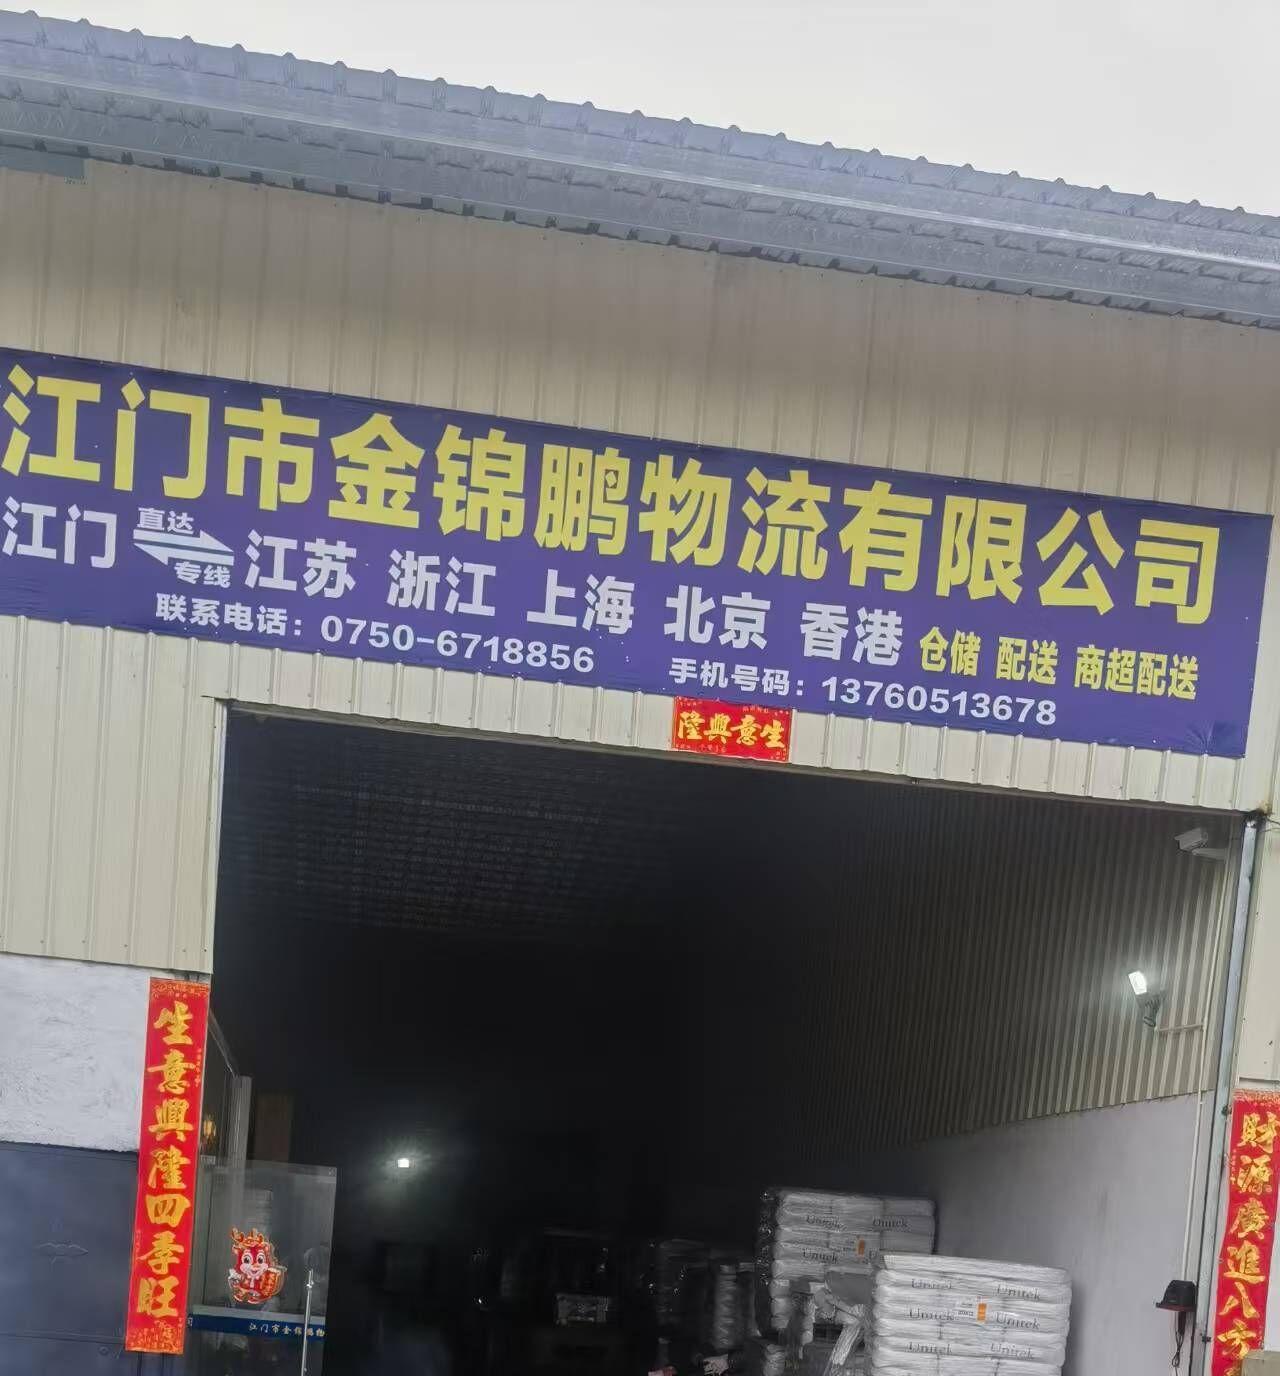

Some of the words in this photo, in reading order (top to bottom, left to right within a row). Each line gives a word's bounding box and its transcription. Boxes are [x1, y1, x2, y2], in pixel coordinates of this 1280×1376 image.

[3, 366, 1219, 623] 江门市金锦鹏物流有限公司
[136, 507, 194, 534] 直达
[174, 562, 231, 589] 专线
[3, 499, 117, 569] 江门
[245, 530, 357, 599] 江苏
[387, 549, 496, 617] 浙江
[527, 568, 635, 635] 上海
[664, 585, 771, 650] 北京
[800, 602, 903, 666] 香港
[920, 626, 981, 677] 仓储
[997, 636, 1058, 684] 配送
[1074, 645, 1198, 699] 商超配送
[137, 1000, 196, 1318] 生意興隆四季旺
